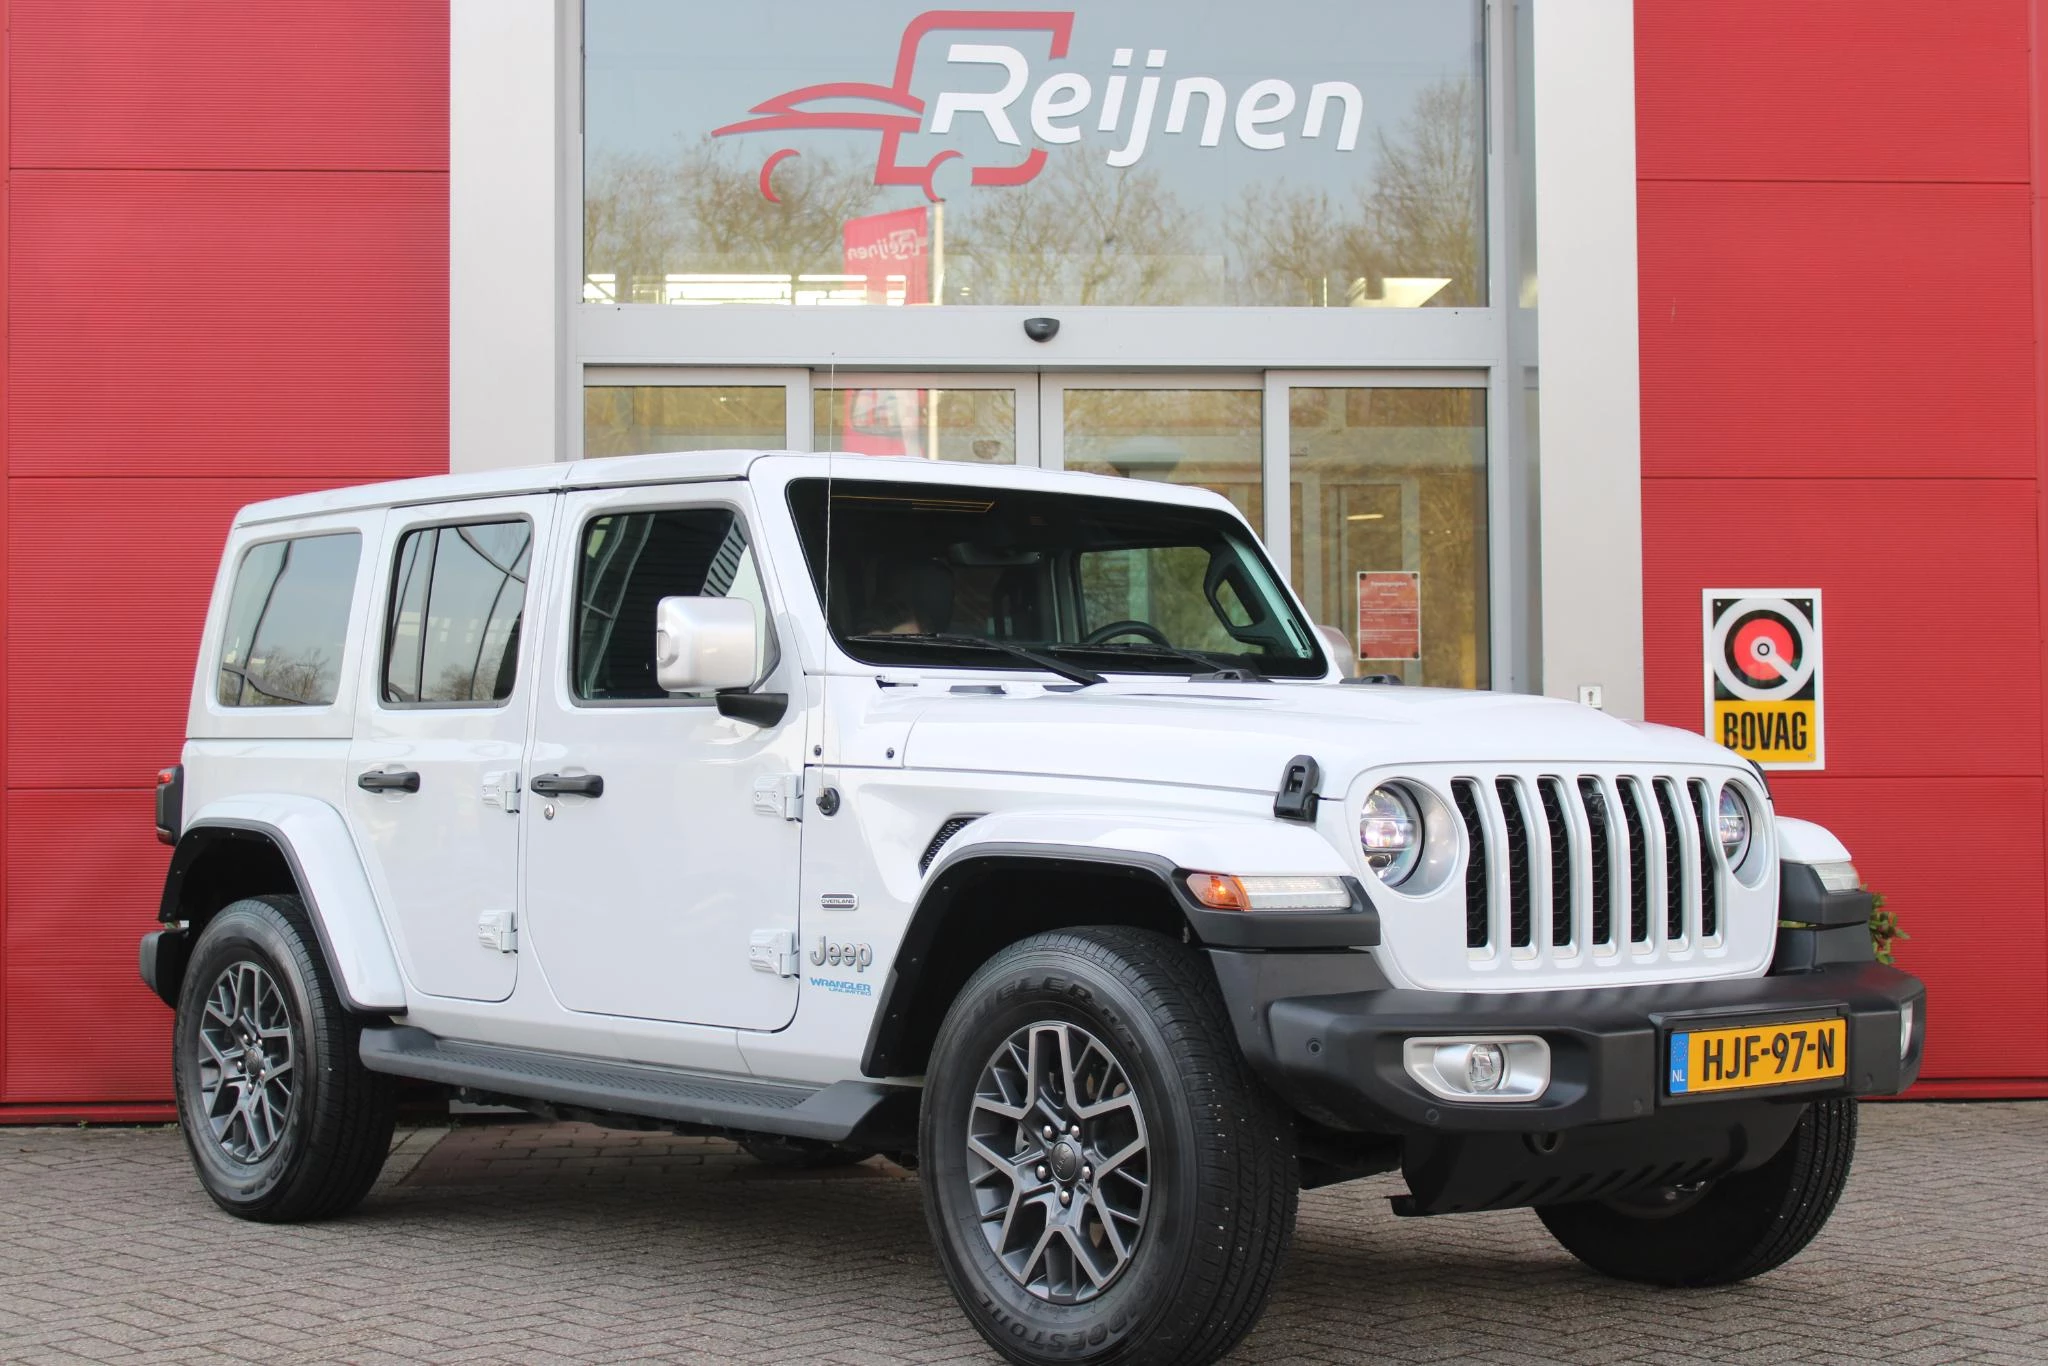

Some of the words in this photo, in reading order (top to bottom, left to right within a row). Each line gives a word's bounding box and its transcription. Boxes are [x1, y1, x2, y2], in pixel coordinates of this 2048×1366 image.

[930, 44, 1364, 168] Reijnen
[1723, 711, 1808, 751] BOVAG
[809, 935, 872, 972] Jeep
[810, 977, 871, 991] WRANGLER
[828, 986, 872, 996] UNLIMITED
[1703, 1027, 1835, 1082] HJF-97-N
[1672, 1069, 1686, 1083] NL
[975, 1263, 1158, 1353] IDGESTONE
